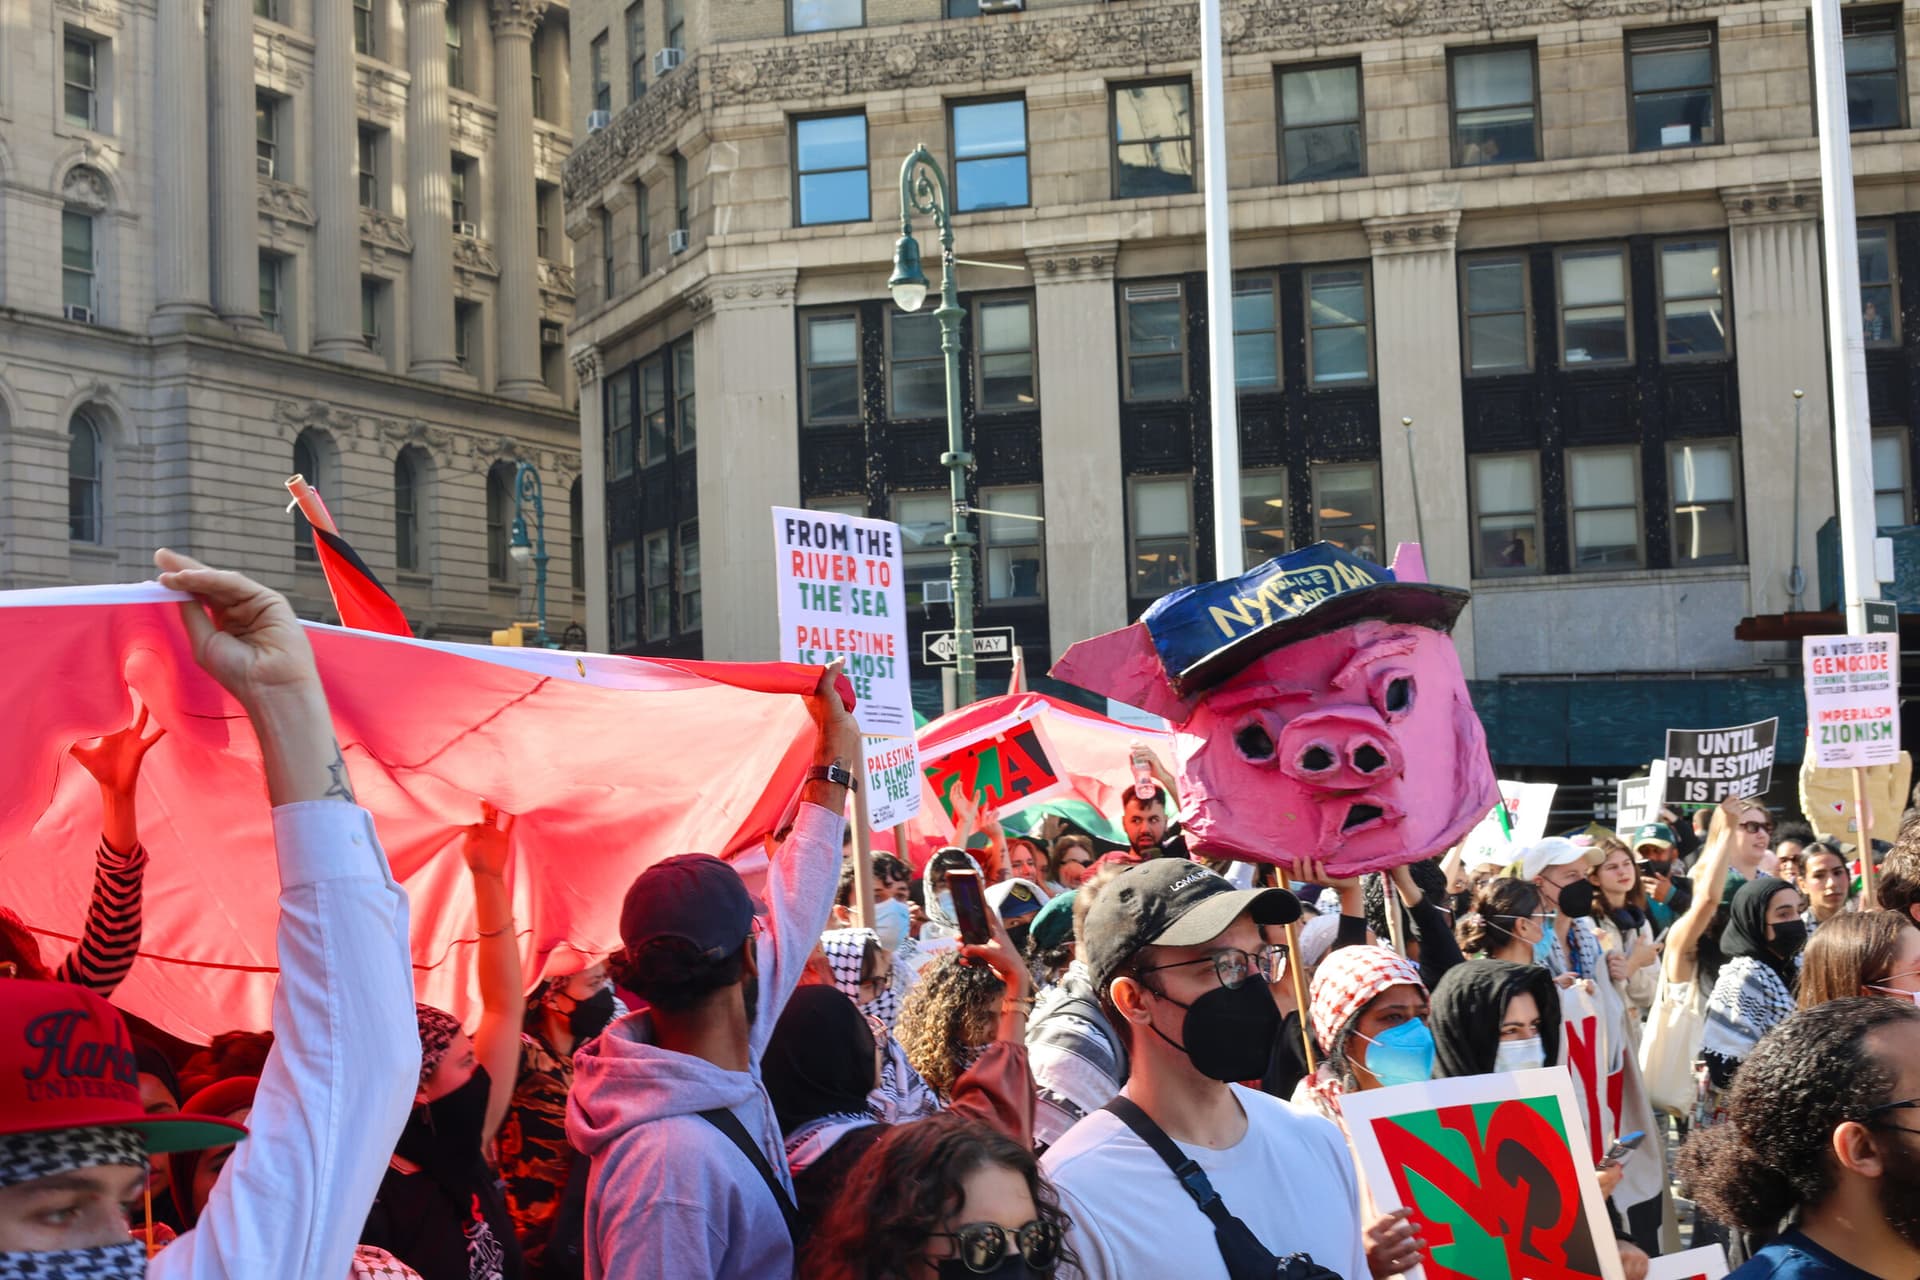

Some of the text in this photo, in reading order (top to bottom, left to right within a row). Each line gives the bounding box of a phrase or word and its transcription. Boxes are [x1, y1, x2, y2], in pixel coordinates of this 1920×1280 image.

[786, 518, 893, 558] FROM THE
[792, 550, 891, 587] RIVER TO
[798, 582, 889, 617] THE SEA
[797, 625, 895, 656] PALESTINE
[938, 639, 1001, 654] ON WAY
[1812, 645, 1826, 656] NO
[1813, 654, 1888, 674] GENOCIDE
[1697, 728, 1758, 755] UNTIL
[1820, 721, 1893, 744] ZIONISM
[867, 743, 914, 774] PALESTINE
[1668, 745, 1774, 778] PALESTINE
[871, 760, 916, 791] IS ALMOST
[1685, 774, 1760, 801] IS FREE
[887, 780, 910, 802] FREE
